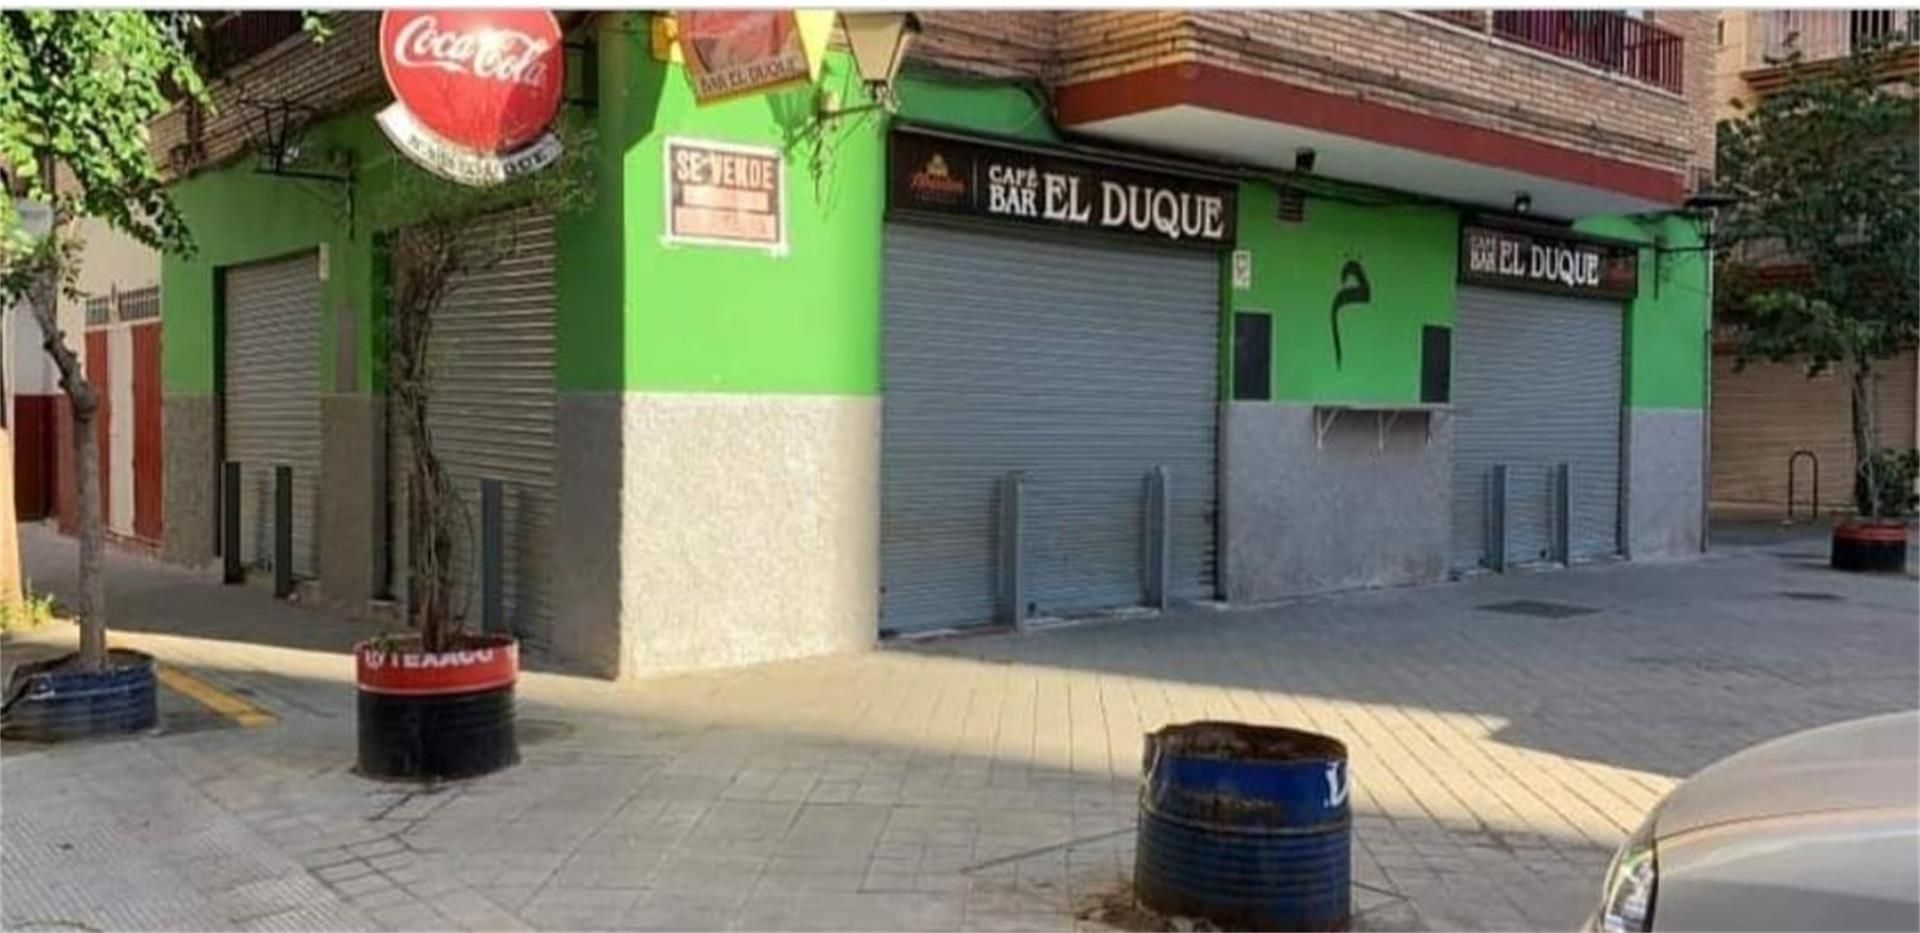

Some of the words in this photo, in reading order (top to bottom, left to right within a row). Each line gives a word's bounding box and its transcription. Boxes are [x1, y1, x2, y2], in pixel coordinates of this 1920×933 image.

[675, 148, 702, 182] SE
[707, 152, 775, 190] VENDE
[988, 163, 1038, 188] CAFÉ
[988, 186, 1038, 217] BAR
[1043, 173, 1092, 223] EL
[1101, 181, 1225, 239] DUQUE
[1500, 240, 1525, 275] EL
[1530, 245, 1600, 286] DUQUE
